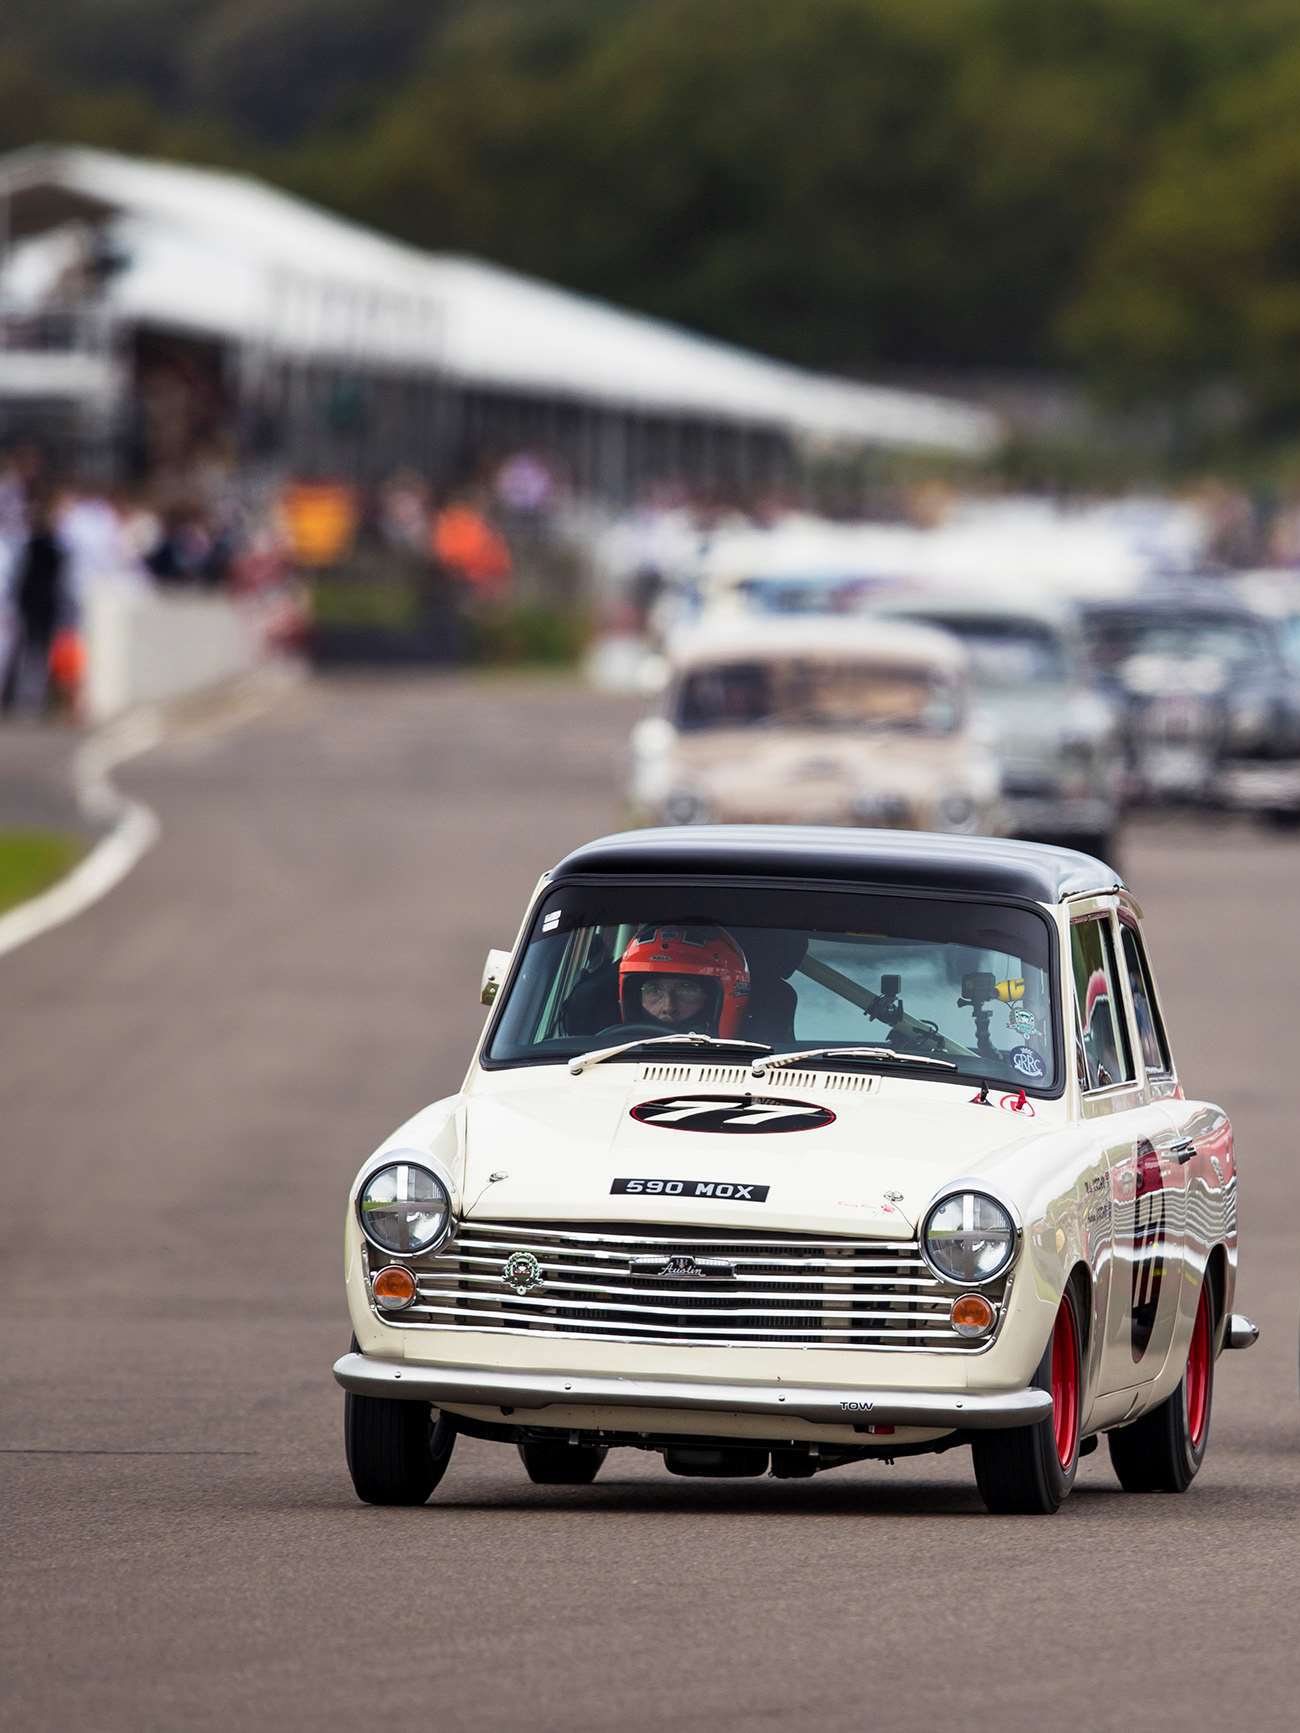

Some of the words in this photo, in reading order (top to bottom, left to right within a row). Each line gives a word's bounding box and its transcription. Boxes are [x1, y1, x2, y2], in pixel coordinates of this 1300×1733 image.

[643, 1100, 824, 1125] 77
[626, 1180, 684, 1195] 590
[694, 1182, 755, 1199] MOX
[658, 1262, 706, 1277] Austin
[840, 1401, 874, 1412] TOW
